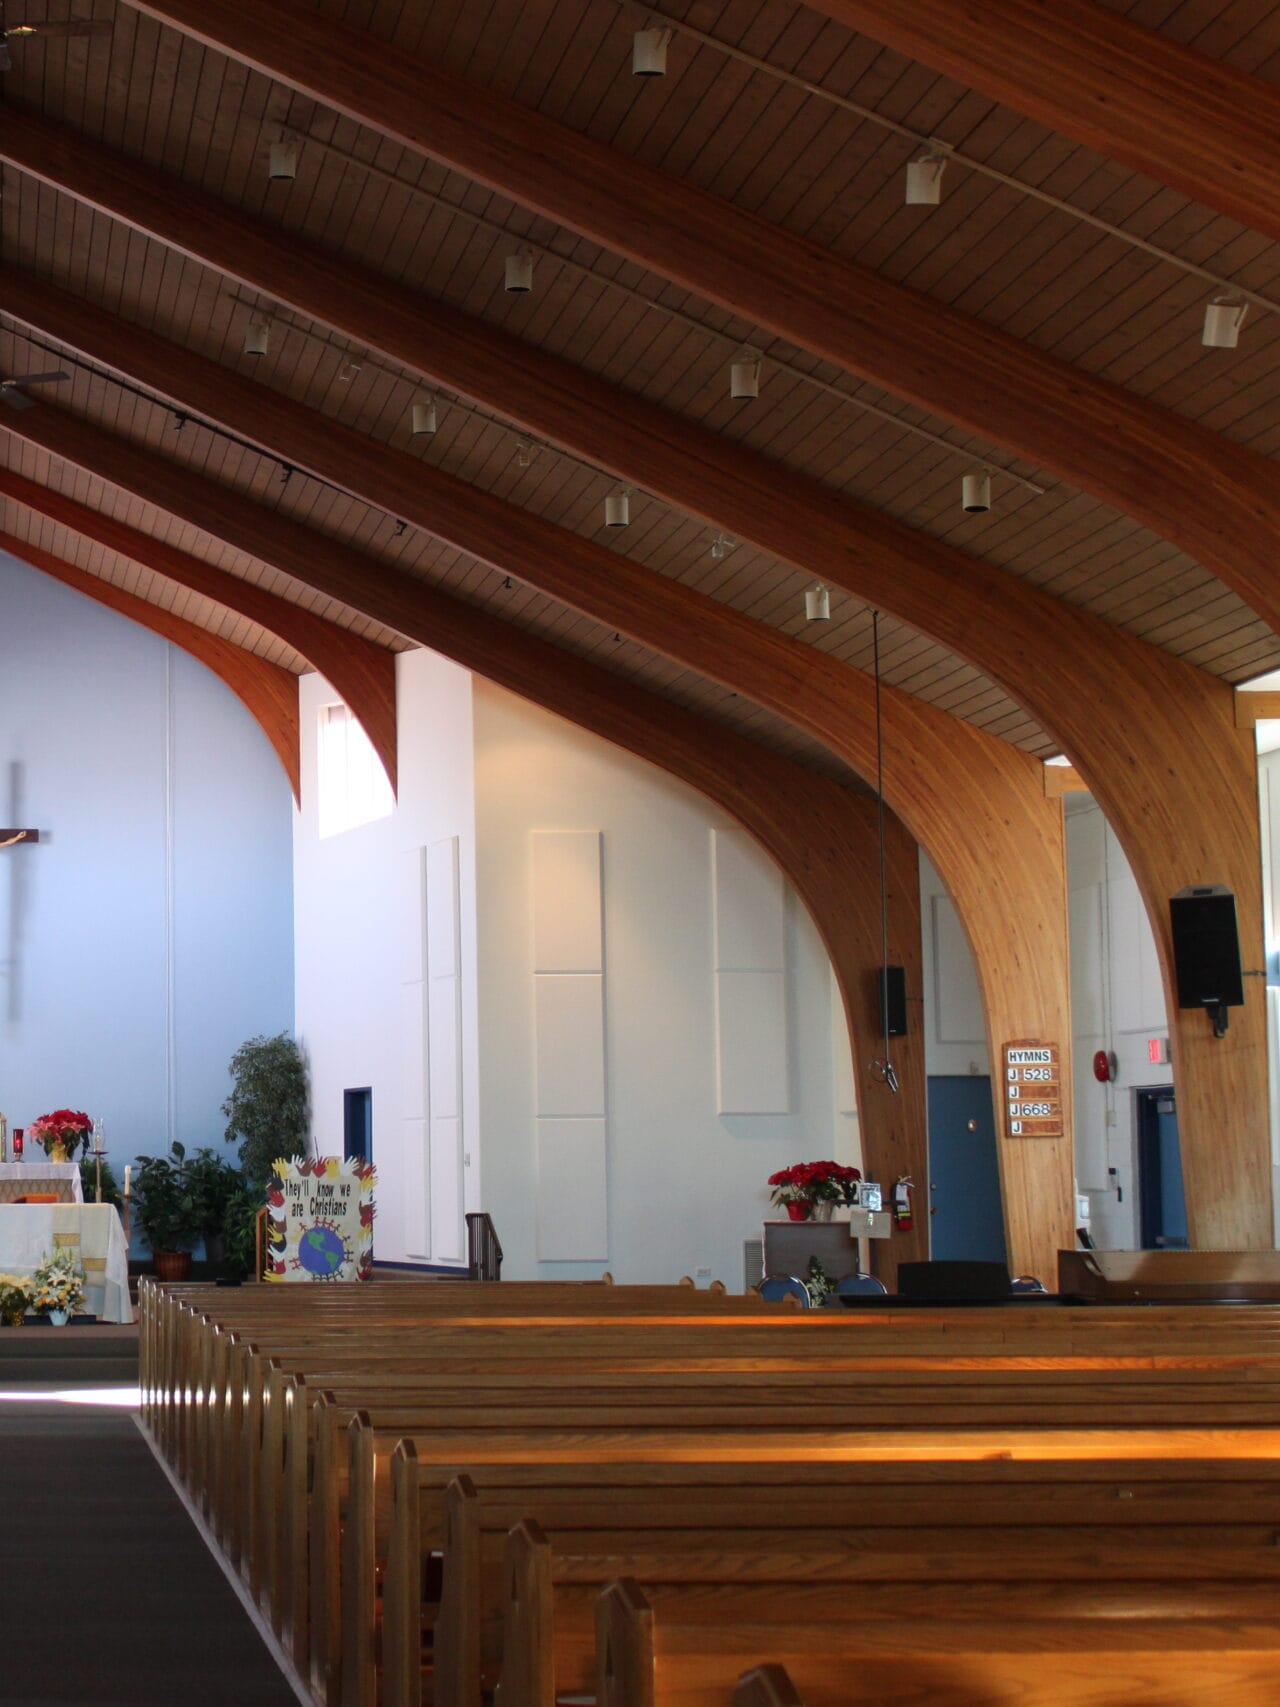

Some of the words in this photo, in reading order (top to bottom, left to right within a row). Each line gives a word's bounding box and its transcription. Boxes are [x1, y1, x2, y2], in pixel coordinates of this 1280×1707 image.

[1009, 1051, 1050, 1062] HYMNS
[1009, 1069, 1017, 1080] J
[1024, 1068, 1051, 1080] 528
[1010, 1087, 1018, 1097] J
[1022, 1103, 1051, 1116] 668
[1013, 1122, 1020, 1133] J
[284, 1178, 309, 1201] They'll
[317, 1179, 335, 1197] know
[340, 1183, 351, 1197] we
[291, 1202, 304, 1217] are
[310, 1197, 347, 1217] Christians
